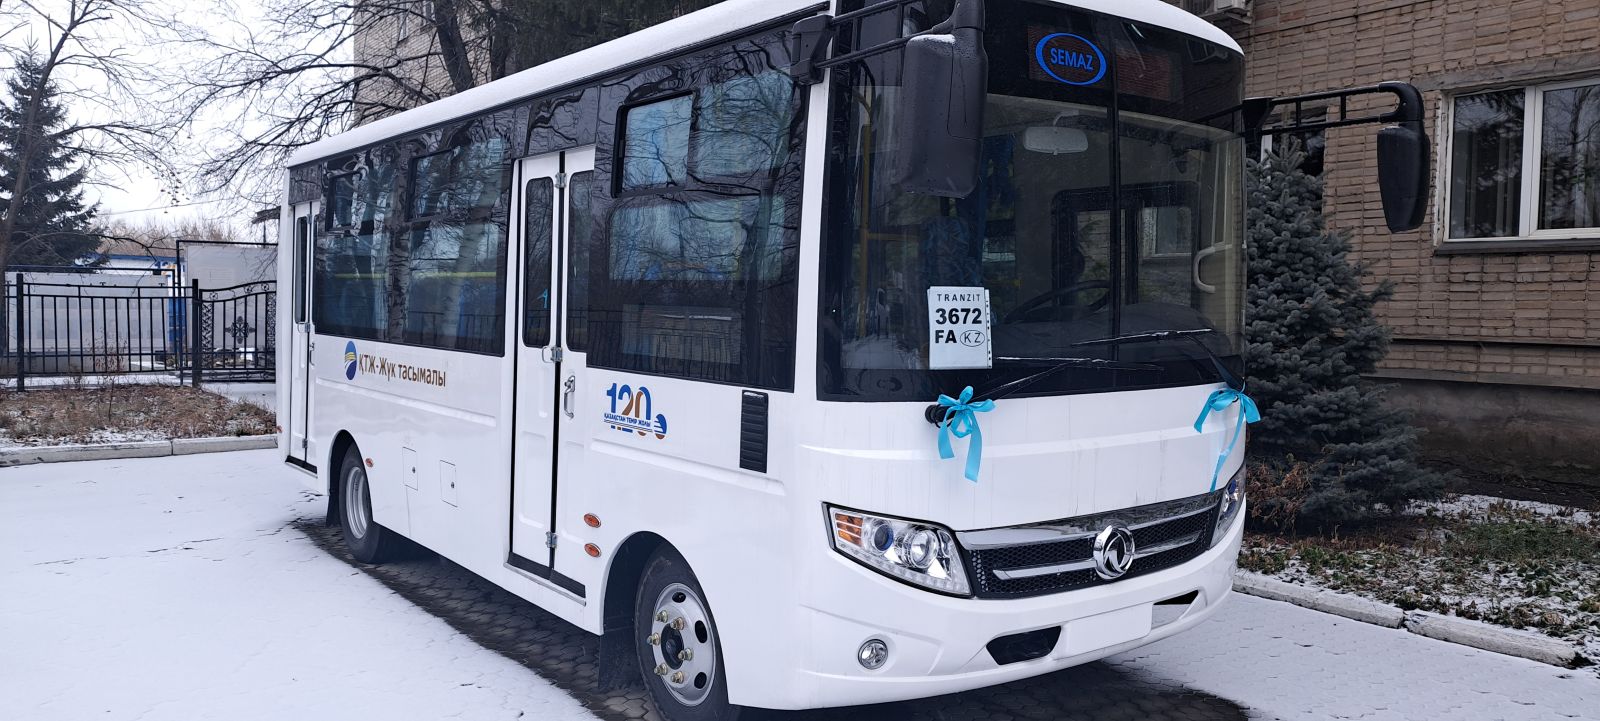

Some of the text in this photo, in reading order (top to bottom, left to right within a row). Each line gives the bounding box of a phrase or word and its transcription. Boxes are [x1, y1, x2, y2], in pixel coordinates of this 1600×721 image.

[1050, 47, 1094, 71] SEMAZ
[937, 293, 981, 302] TRANZIT
[935, 308, 982, 325] 3672
[935, 329, 981, 344] FA KZ
[359, 353, 446, 387] ҚТЖ-Жүк тасымалы
[606, 382, 652, 421] 120
